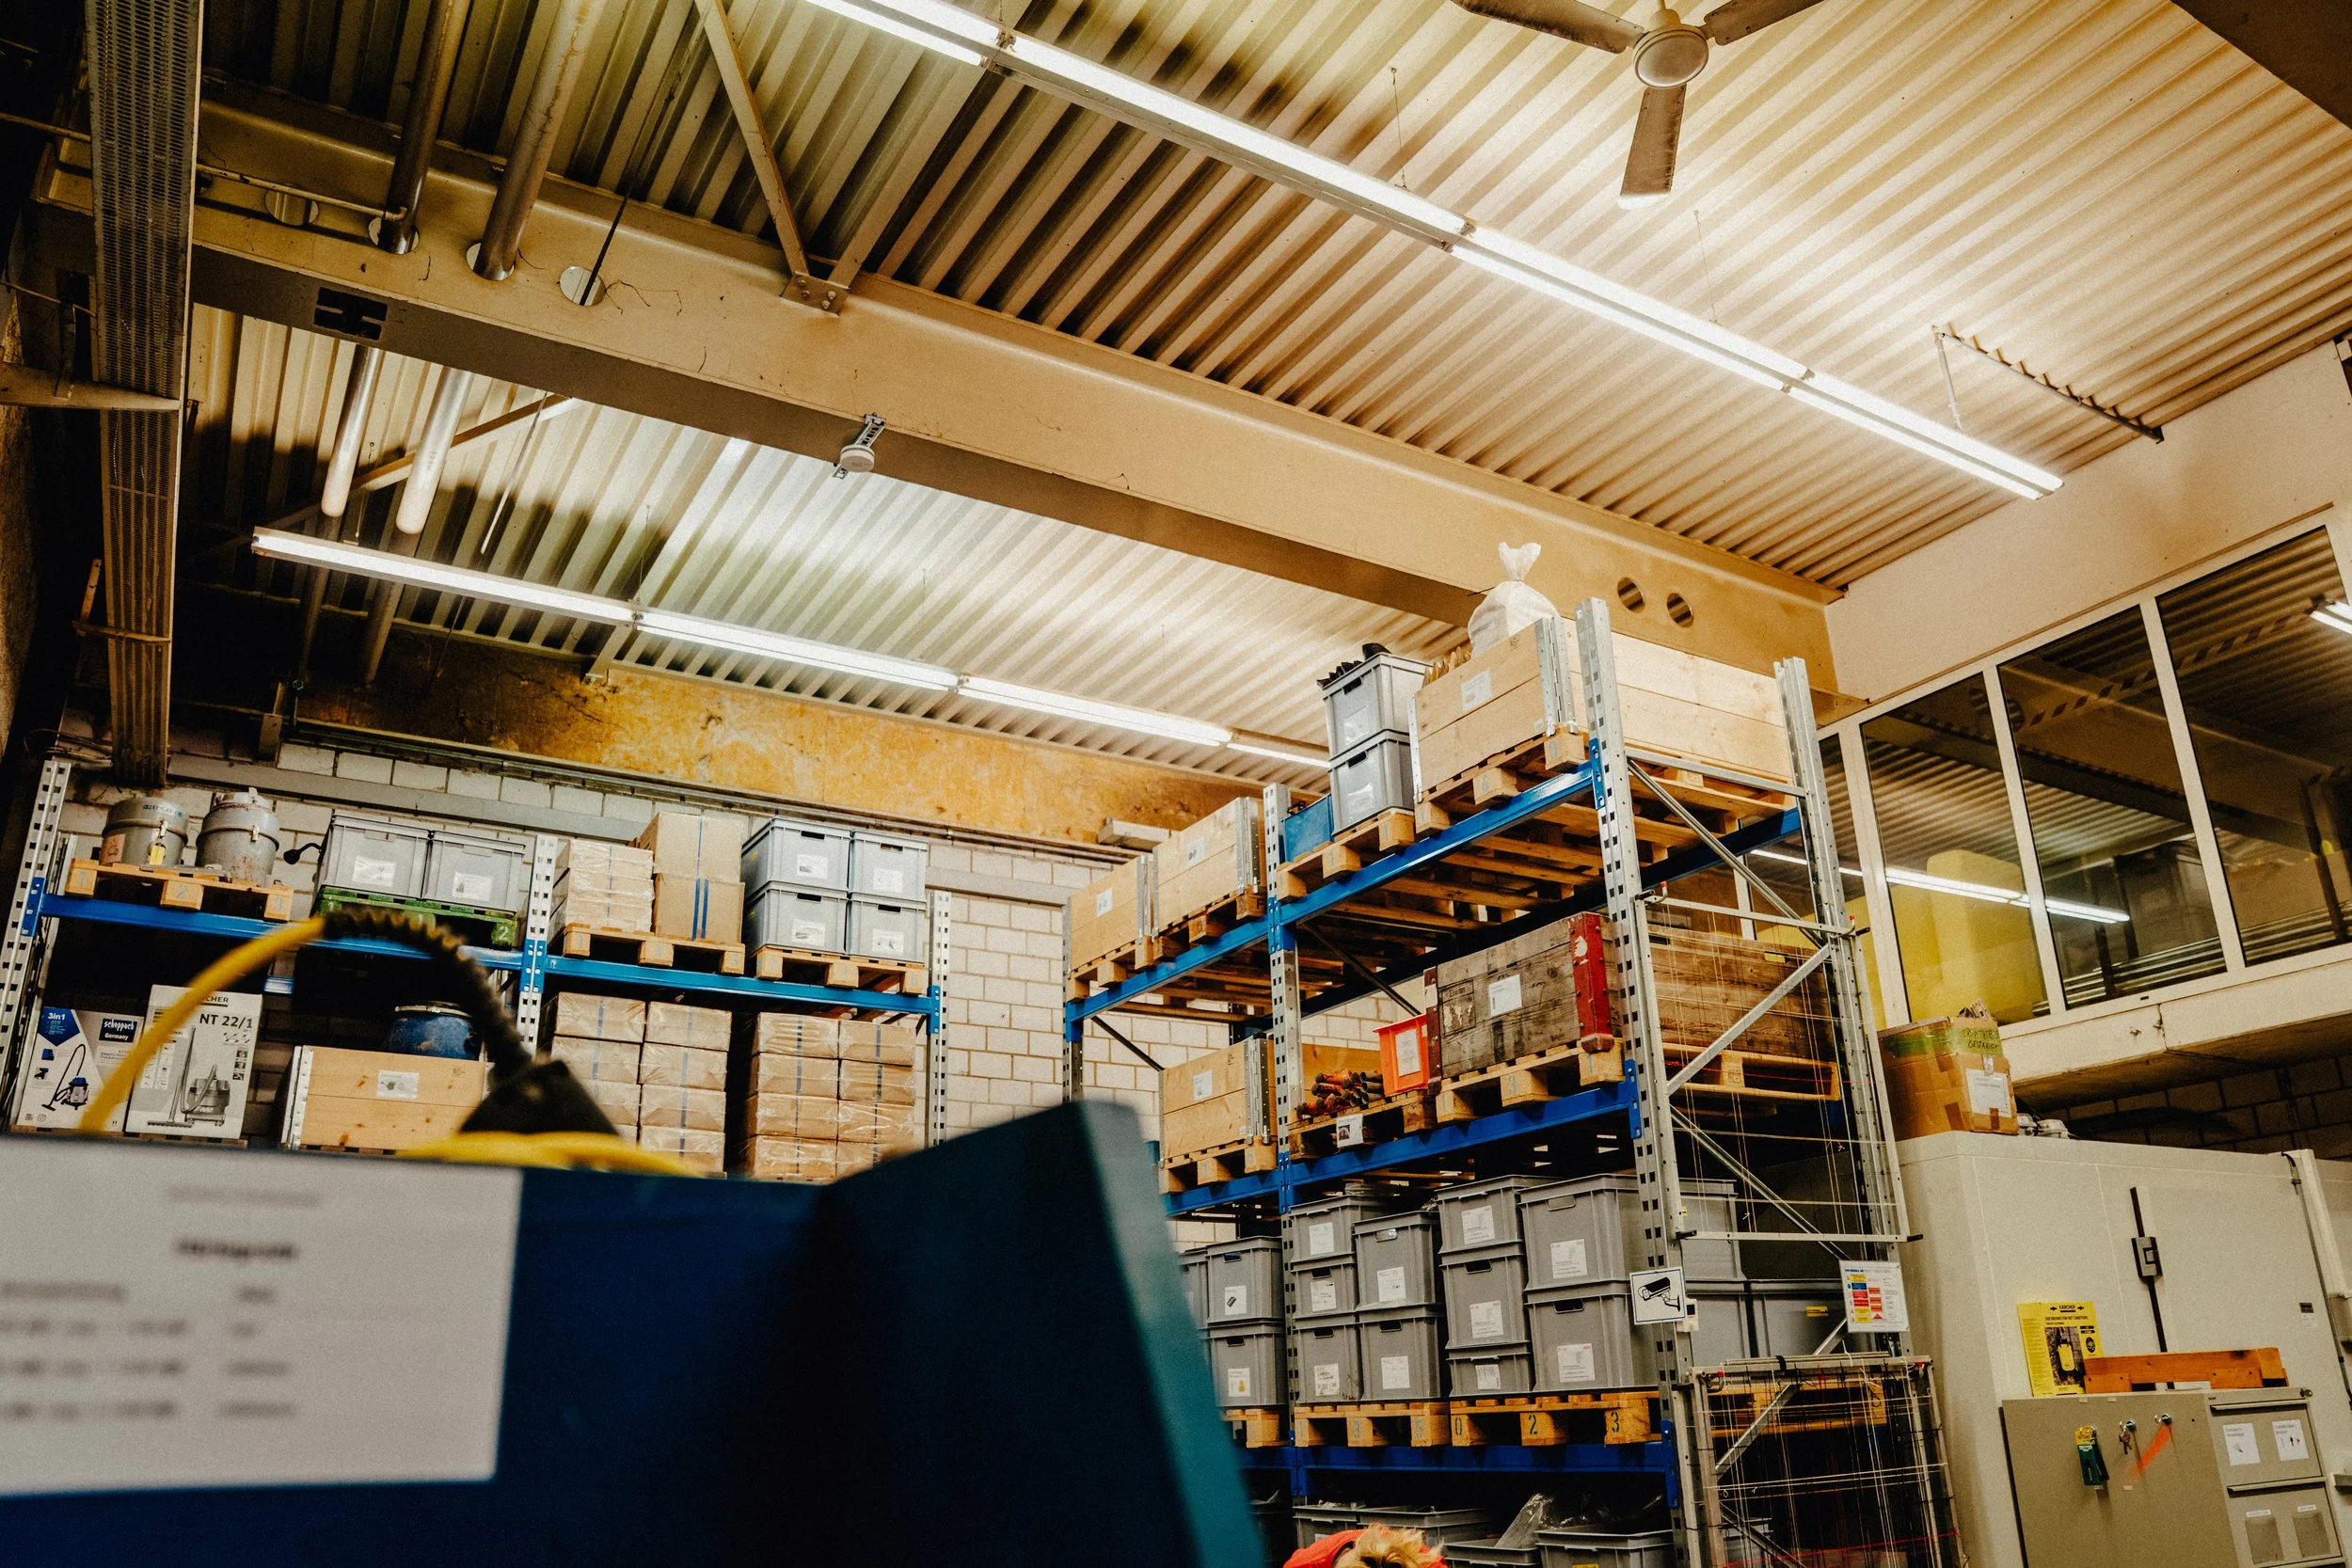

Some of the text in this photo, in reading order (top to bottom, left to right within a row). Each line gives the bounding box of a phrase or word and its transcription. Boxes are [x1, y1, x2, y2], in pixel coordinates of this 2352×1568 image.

[176, 883, 189, 900] 2
[499, 925, 509, 942] 2
[47, 1012, 66, 1022] 3in1
[103, 1018, 135, 1033] scheppach
[199, 1013, 253, 1029] NT 22/1
[104, 1032, 130, 1041] Germany
[1507, 1076, 1518, 1096] 3
[1353, 1420, 1361, 1438] 3
[1454, 1417, 1463, 1436] 0
[1527, 1414, 1538, 1435] 2
[1611, 1410, 1620, 1433] 3
